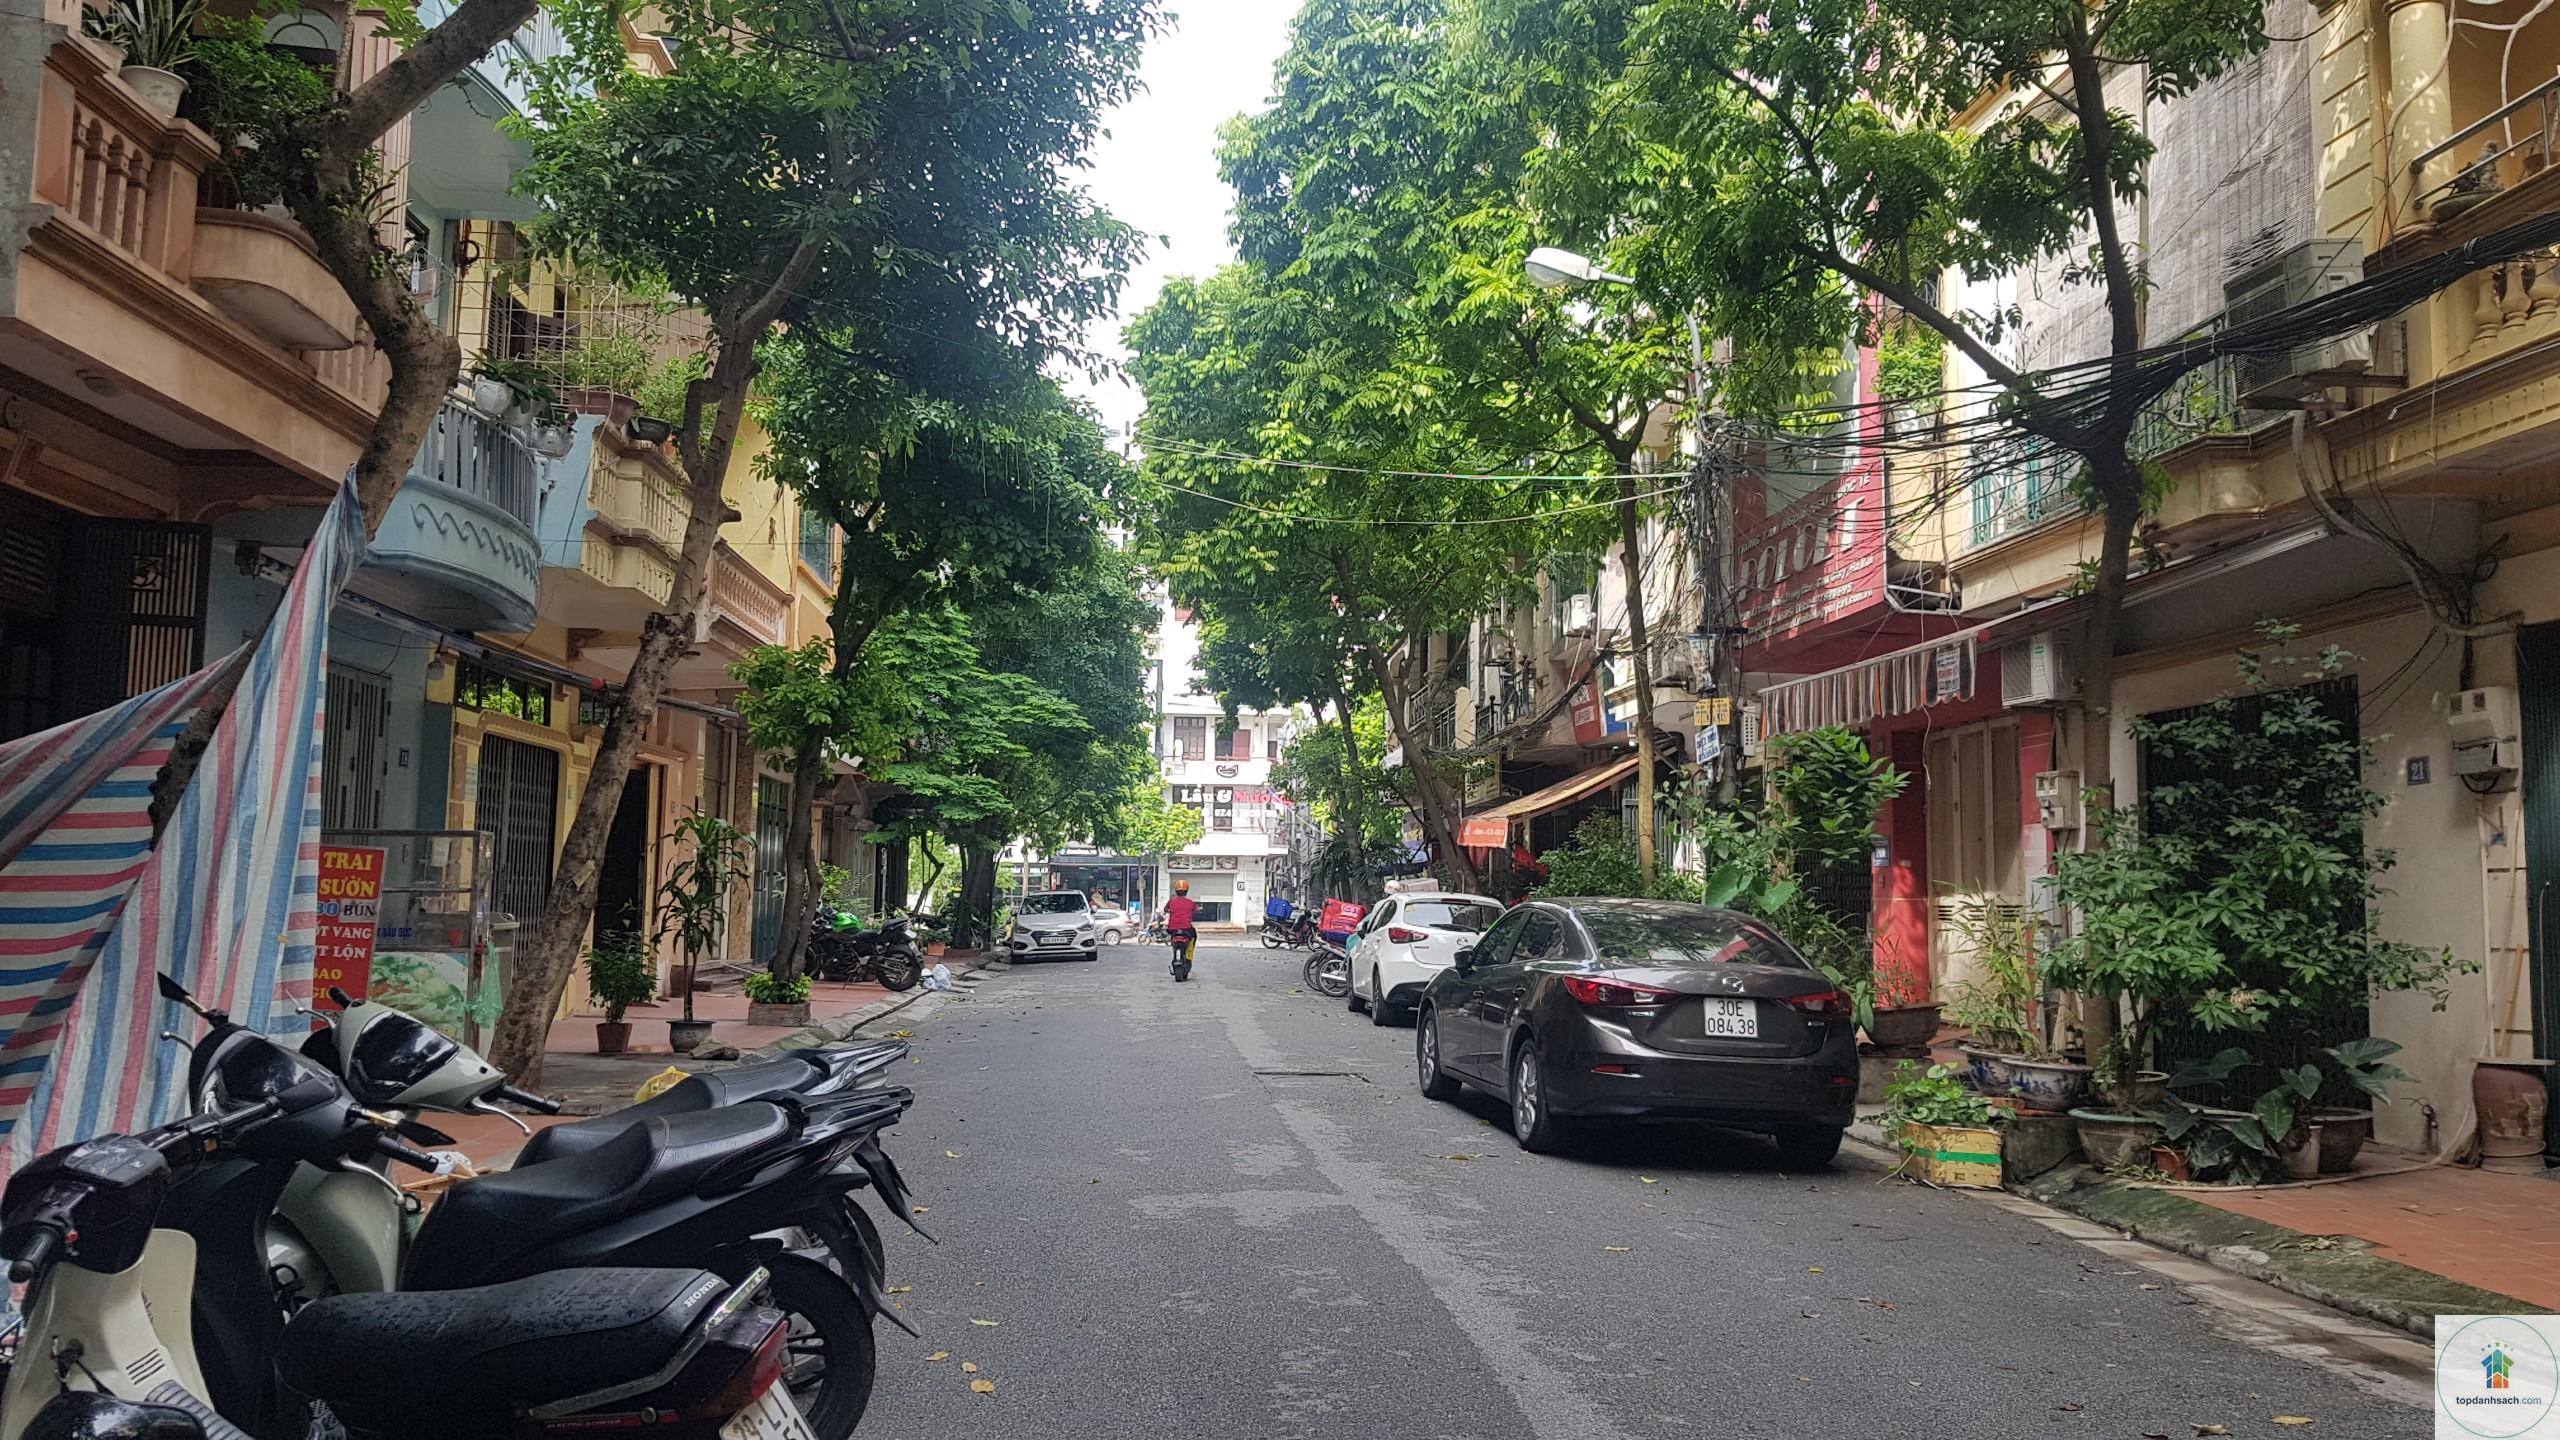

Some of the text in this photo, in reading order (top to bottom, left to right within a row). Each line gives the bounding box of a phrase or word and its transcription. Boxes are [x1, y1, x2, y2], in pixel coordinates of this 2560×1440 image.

[2410, 761, 2424, 780] 21
[323, 851, 373, 871] TRAI
[319, 874, 376, 897] SƯỜN
[344, 902, 376, 916] BÚN
[332, 926, 372, 939] VANG
[332, 943, 367, 961] LỘN
[1717, 1000, 1744, 1017] 30E
[1707, 1017, 1755, 1035] 084.38
[683, 1277, 720, 1308] HONDA
